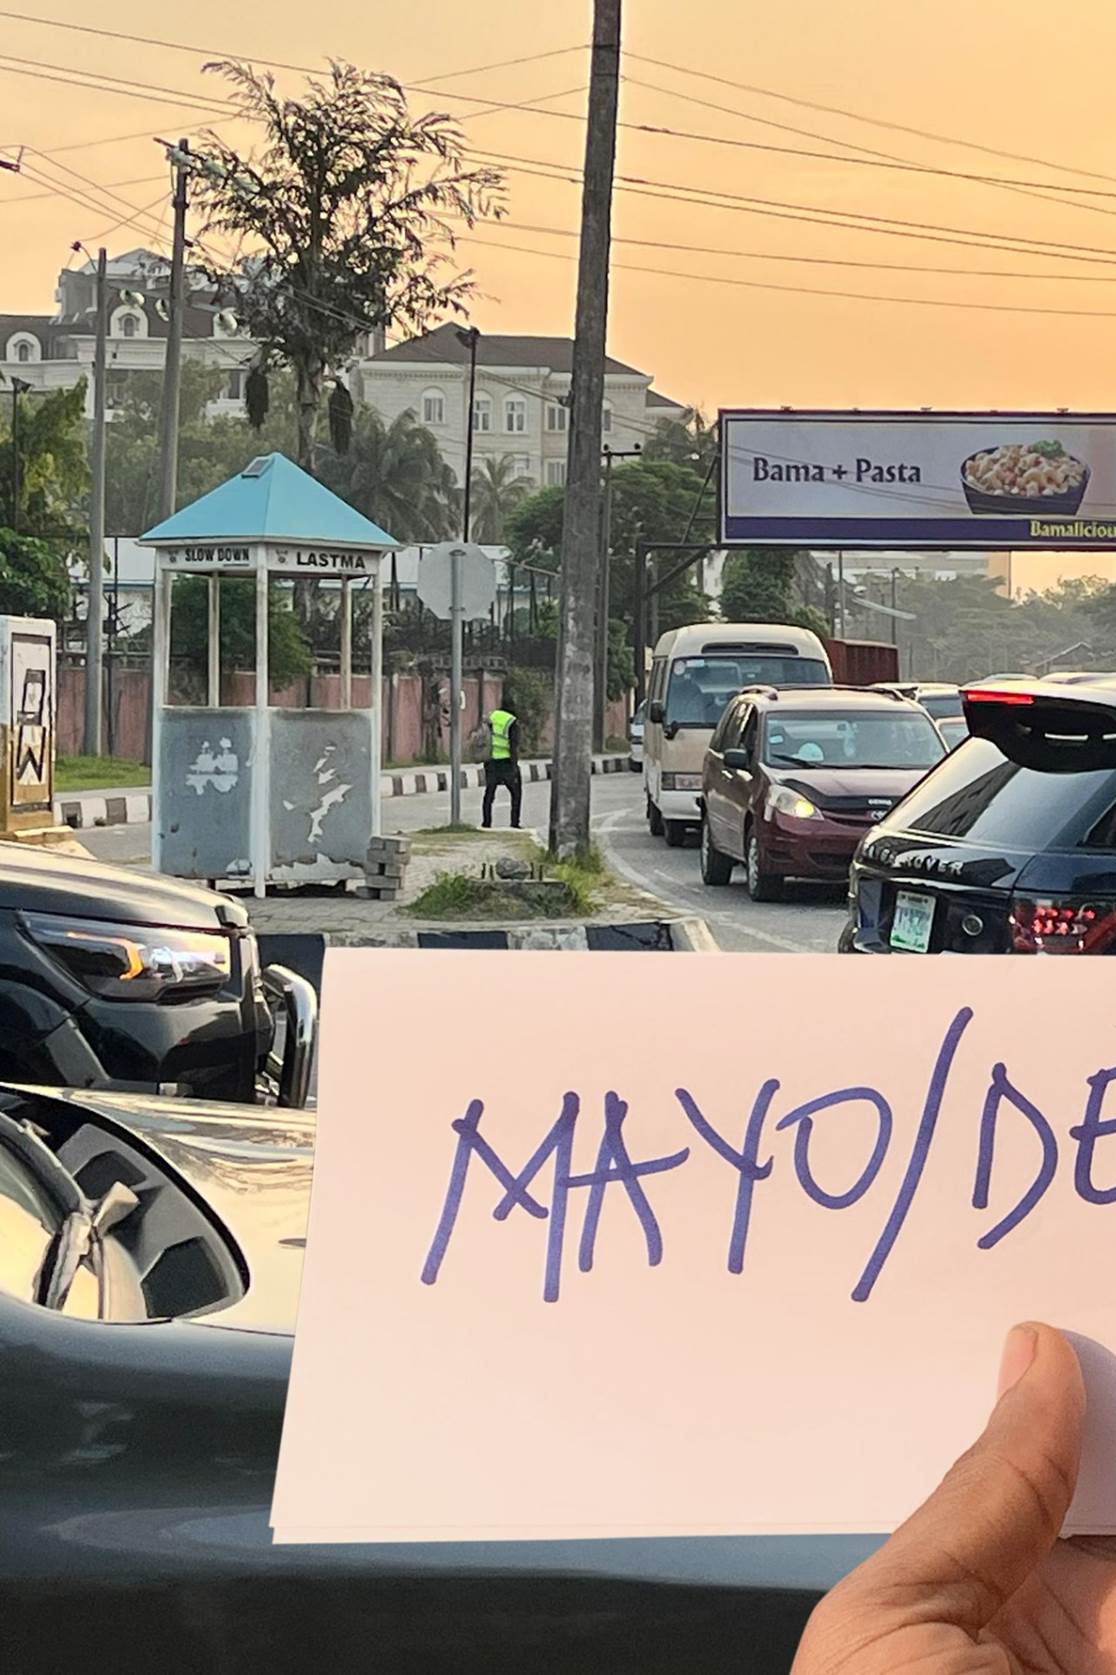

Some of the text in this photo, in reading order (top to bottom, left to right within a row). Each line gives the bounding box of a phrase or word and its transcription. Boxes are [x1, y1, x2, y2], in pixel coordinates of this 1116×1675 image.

[753, 456, 824, 482] Bama
[855, 458, 921, 483] Pasta
[184, 547, 250, 562] SLOW DOWN
[296, 551, 366, 570] LASTMA
